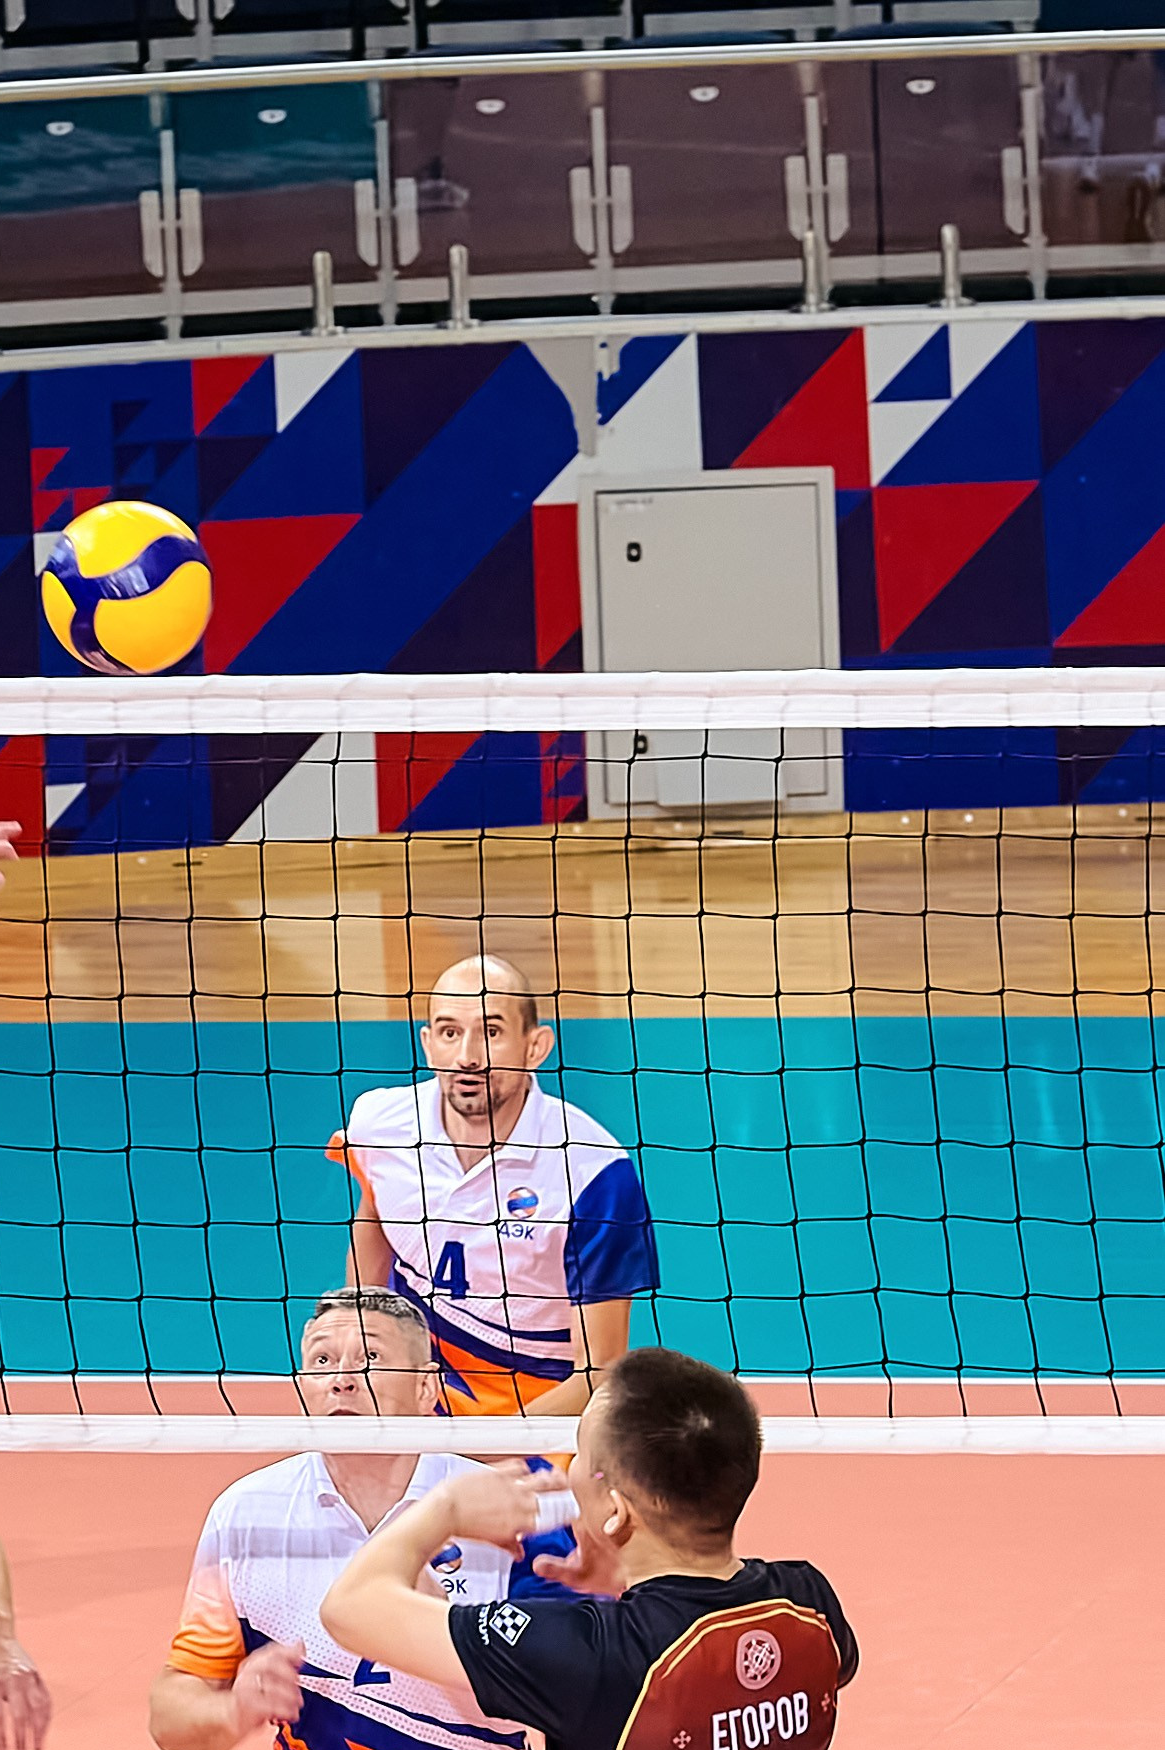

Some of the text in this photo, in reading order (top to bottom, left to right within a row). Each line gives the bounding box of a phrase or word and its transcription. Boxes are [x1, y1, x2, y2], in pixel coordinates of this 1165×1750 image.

[498, 1221, 535, 1240] ДЭК
[433, 1240, 470, 1300] 4
[441, 1578, 468, 1594] ЭК
